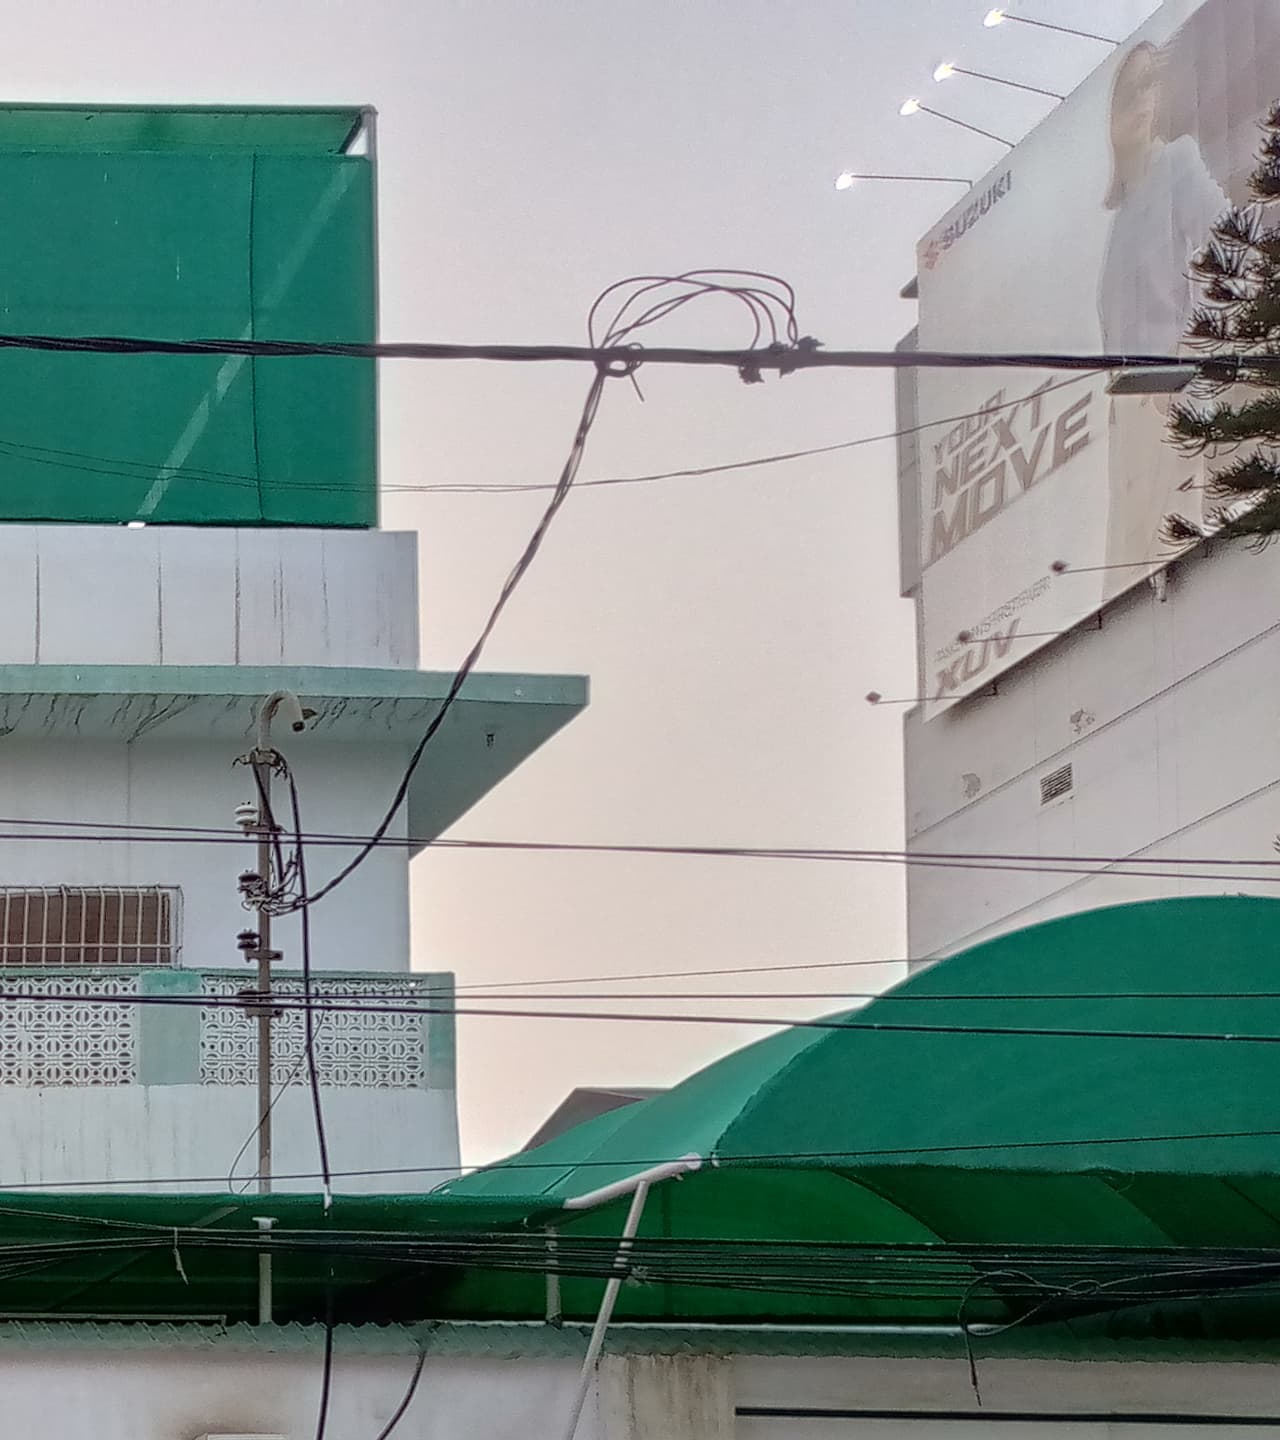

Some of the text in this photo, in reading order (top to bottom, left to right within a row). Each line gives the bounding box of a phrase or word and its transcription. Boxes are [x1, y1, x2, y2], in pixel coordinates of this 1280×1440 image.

[941, 170, 1012, 251] SUZUKI
[930, 391, 1093, 559] MOVE
[933, 386, 1007, 465] YOUR
[934, 376, 1055, 509] NEXT
